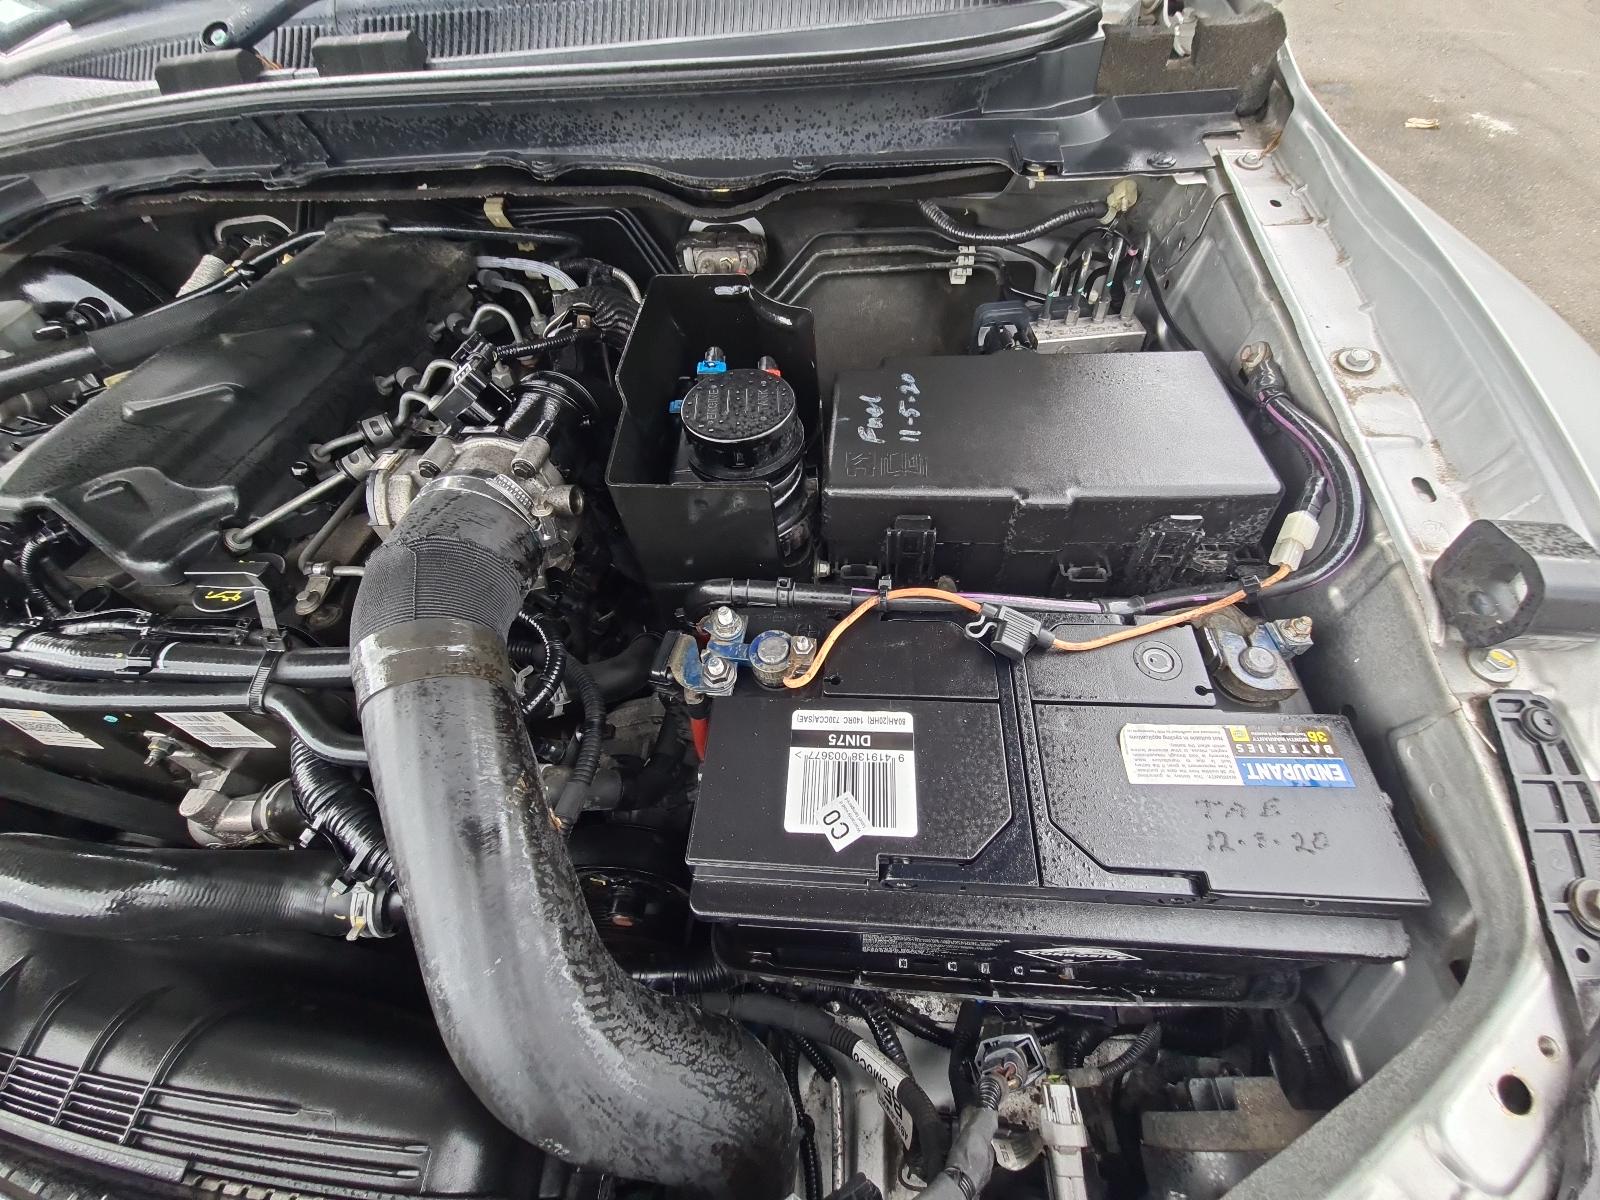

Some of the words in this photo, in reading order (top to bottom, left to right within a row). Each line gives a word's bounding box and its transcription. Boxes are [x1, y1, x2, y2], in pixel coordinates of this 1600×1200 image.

[828, 733, 871, 746] DIN75
[1307, 730, 1329, 742] 36
[1235, 743, 1334, 755] BATTERIES
[808, 751, 848, 761] 003677
[851, 752, 891, 762] 419138
[898, 753, 905, 762] 9
